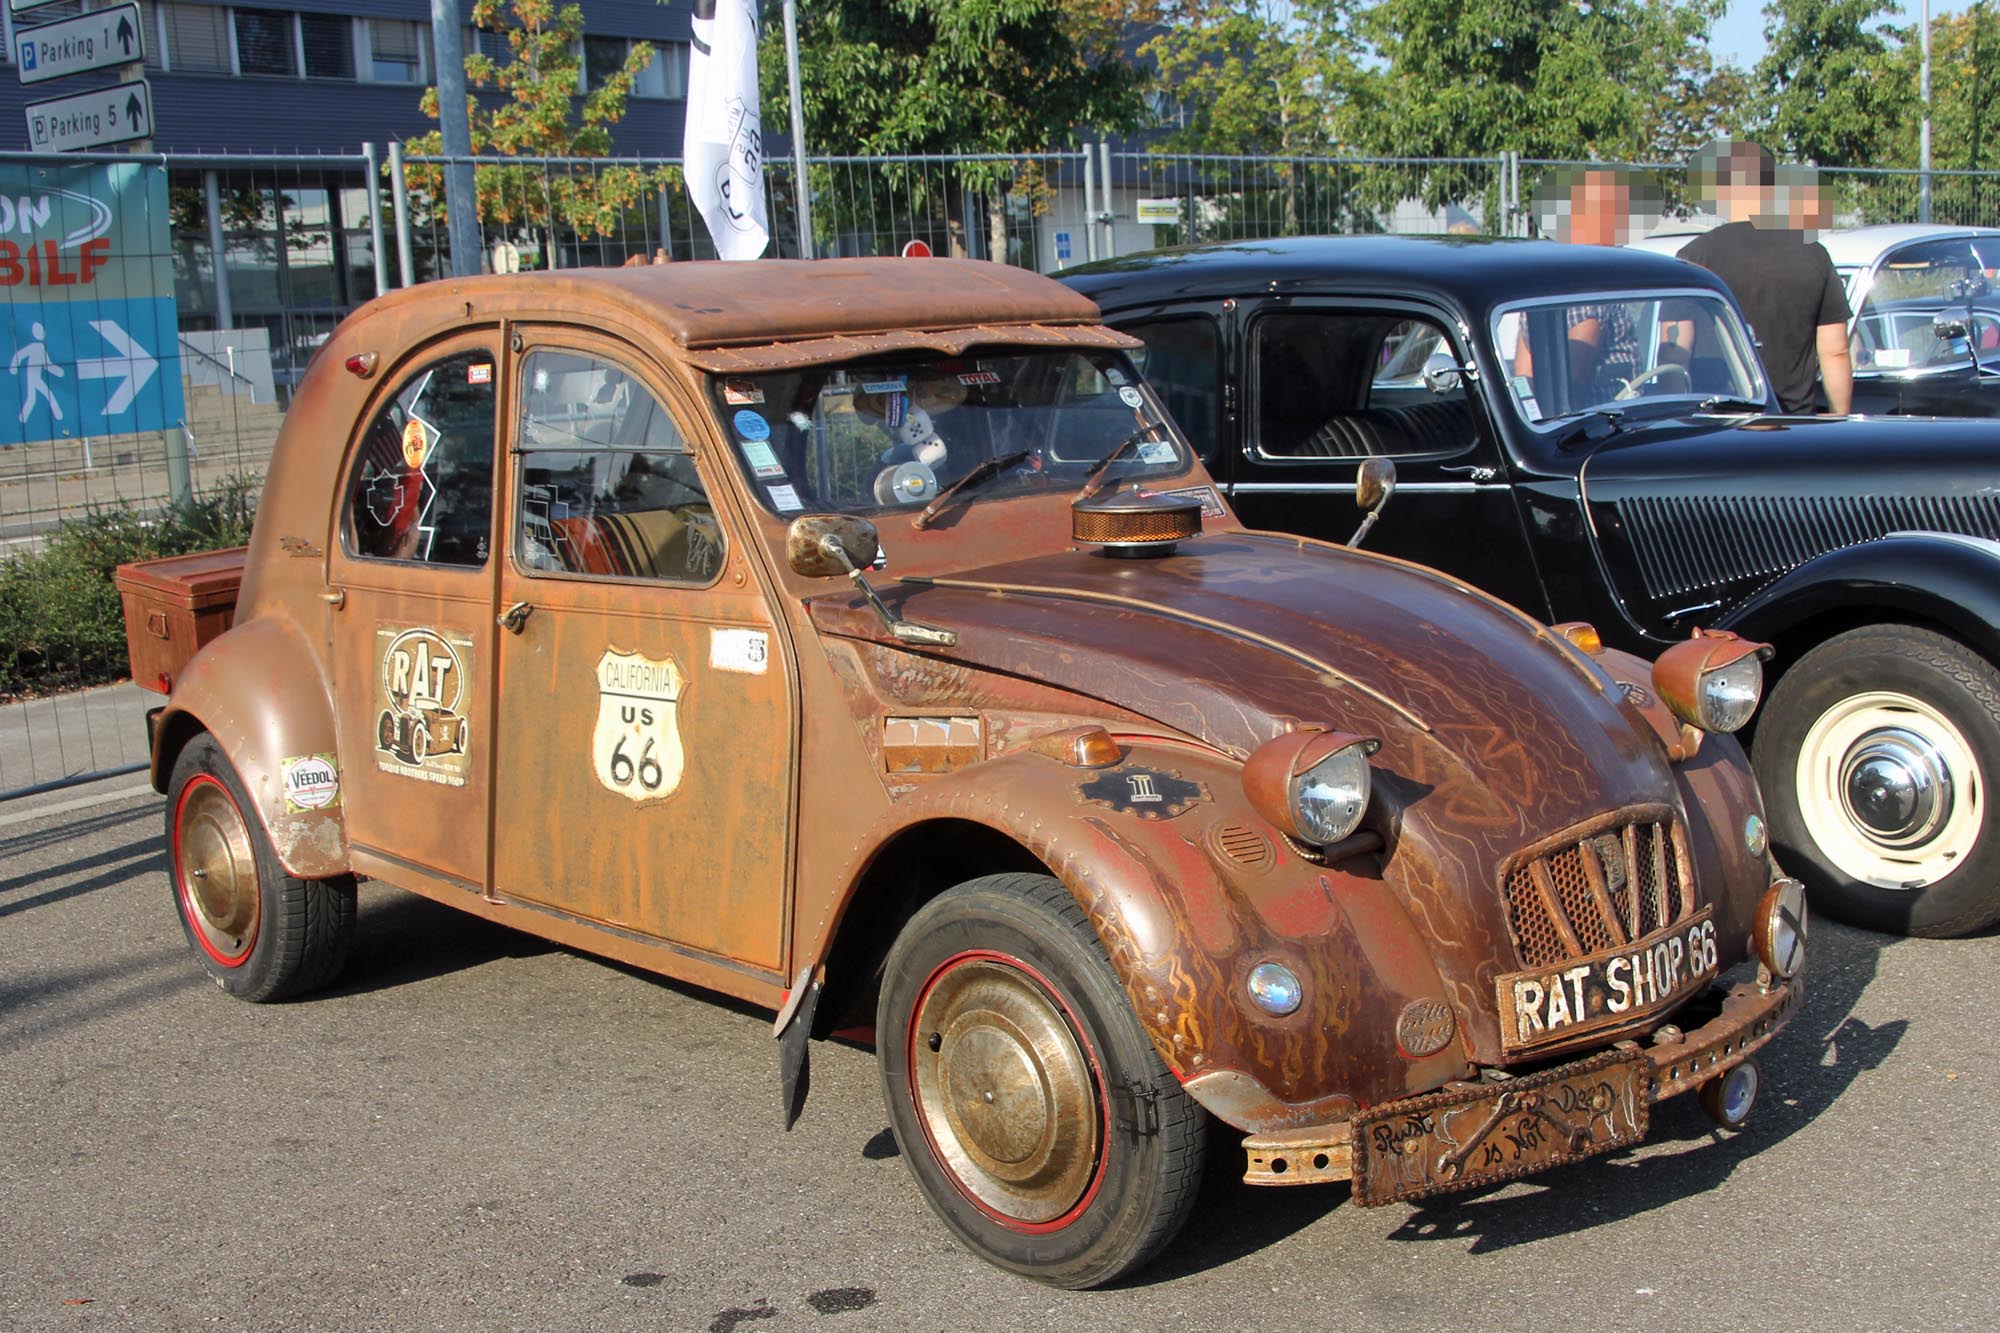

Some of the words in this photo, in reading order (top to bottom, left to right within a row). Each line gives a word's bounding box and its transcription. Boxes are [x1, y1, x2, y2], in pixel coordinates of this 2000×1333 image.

[41, 37, 94, 64] Parking
[104, 27, 109, 49] 1
[51, 112, 100, 138] Parking
[108, 104, 117, 127] 5
[960, 372, 999, 384] TOTAL
[392, 640, 452, 707] RAT
[605, 661, 671, 694] CALIFORNIA
[621, 705, 654, 726] US
[291, 770, 333, 789] VEEDOL
[429, 771, 447, 785] SPEED
[611, 736, 662, 791] 66
[1514, 965, 1591, 1043] RAT
[1606, 936, 1683, 1014] SHOP
[1688, 919, 1718, 977] 66
[1483, 1142, 1503, 1167] is
